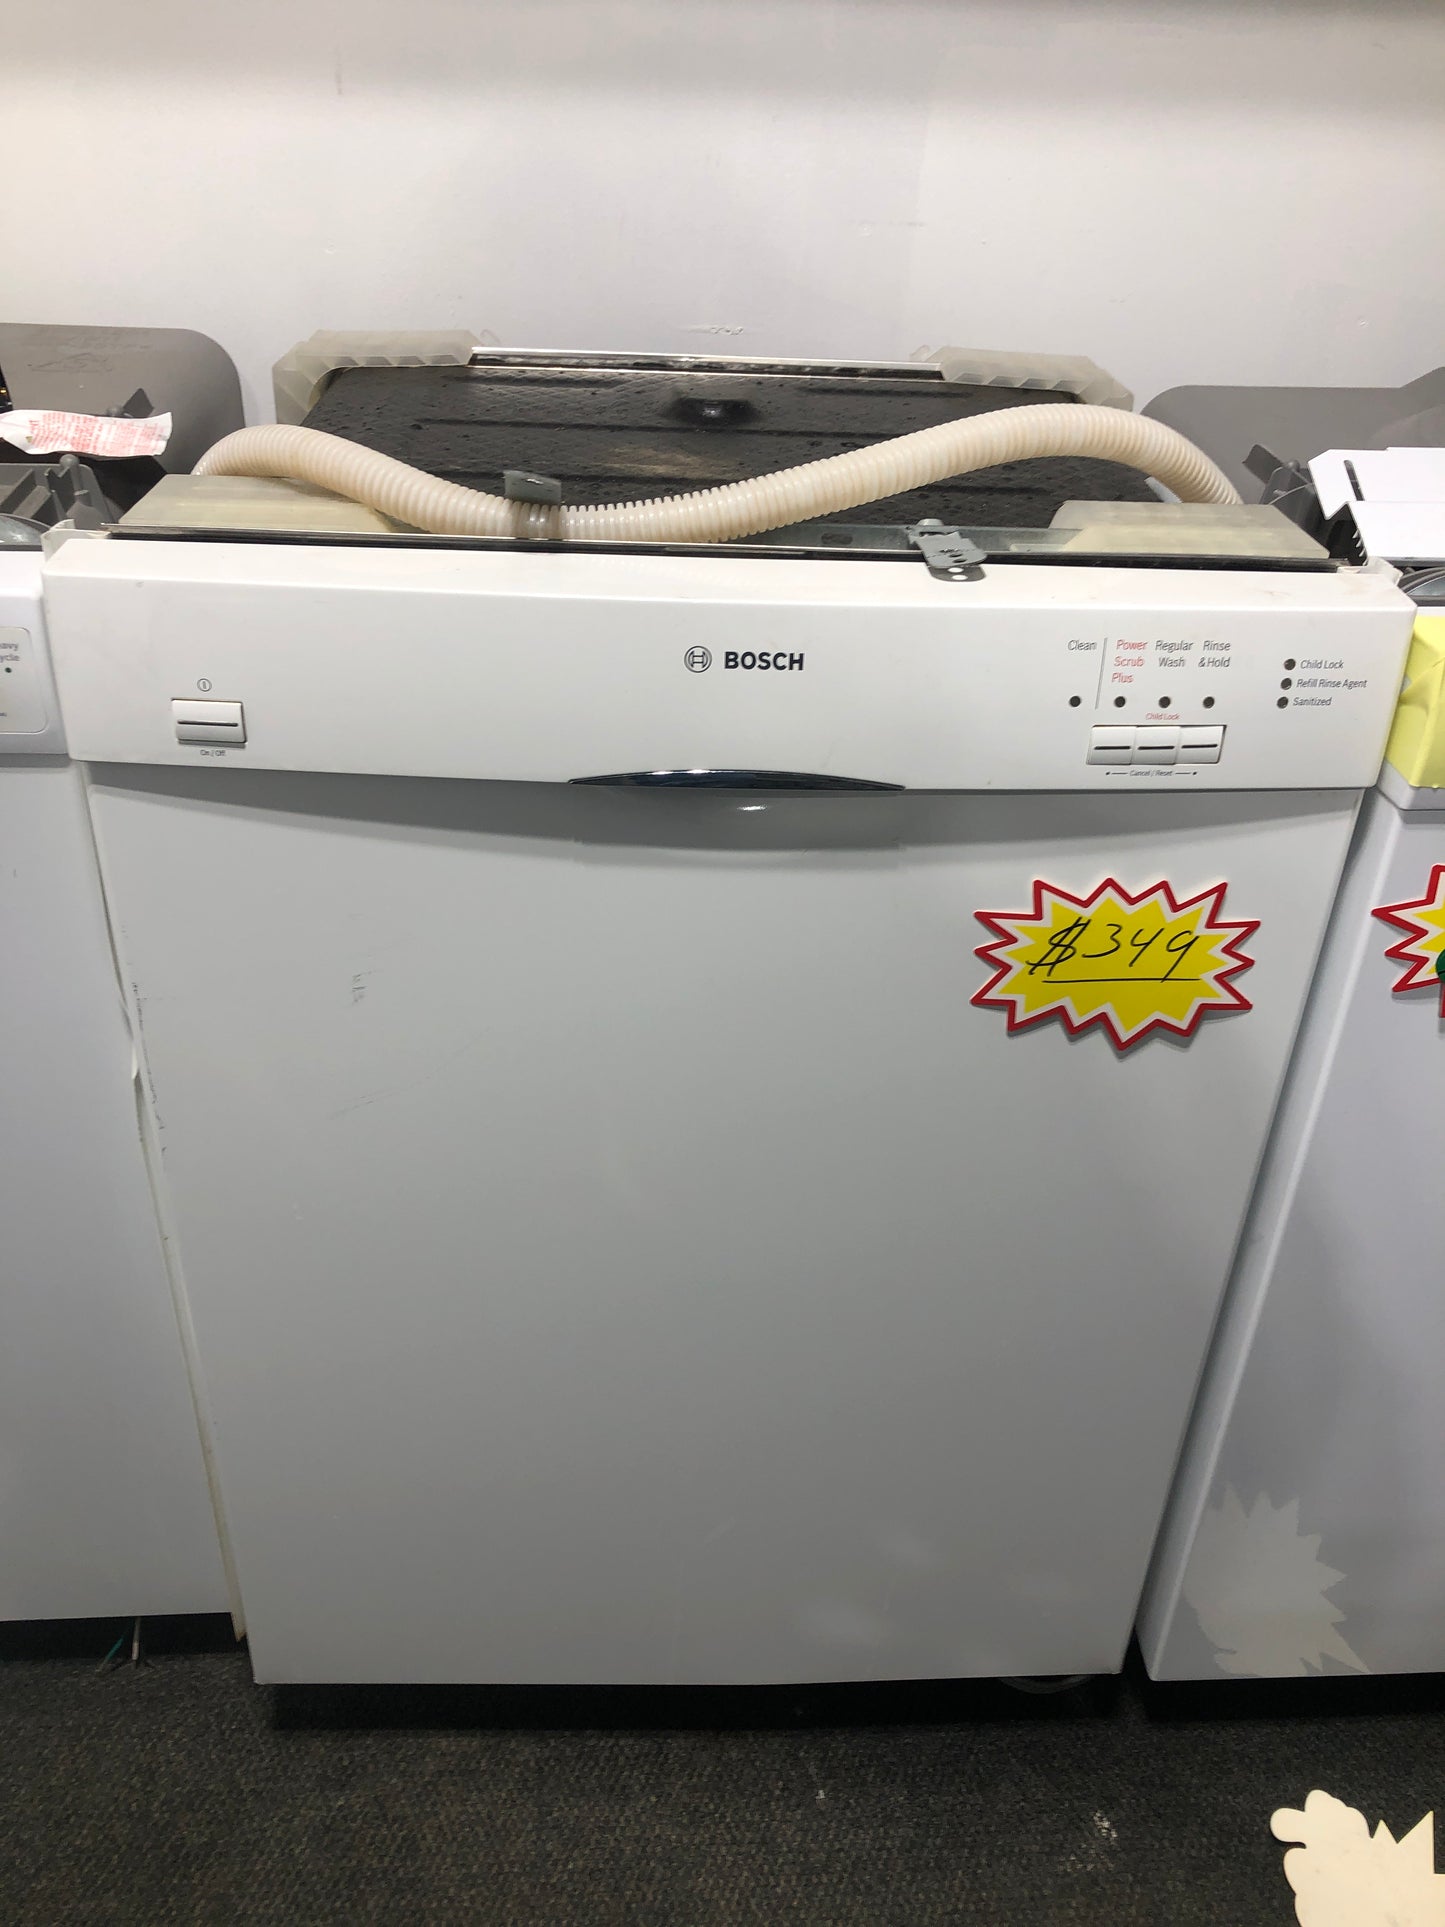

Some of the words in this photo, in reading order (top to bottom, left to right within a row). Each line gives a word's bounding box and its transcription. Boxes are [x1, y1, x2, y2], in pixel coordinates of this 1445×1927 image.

[1067, 639, 1097, 651] Clean
[1116, 639, 1148, 650] Power
[1155, 640, 1194, 653] Regular
[1203, 640, 1231, 651] Rinse
[724, 651, 804, 671] BOSCH
[1113, 655, 1145, 667] Scrub
[1158, 656, 1186, 667] Wash
[1300, 659, 1323, 669] Child
[1323, 659, 1344, 669] Lock
[1111, 671, 1134, 683] Plus
[1296, 678, 1318, 688] Refill
[1318, 678, 1341, 688] Rinse
[1342, 679, 1368, 690] Agent
[1293, 696, 1332, 706] Sanitized
[1145, 712, 1163, 720] Child
[1164, 712, 1180, 720] Lock
[1025, 916, 1200, 983] $349
